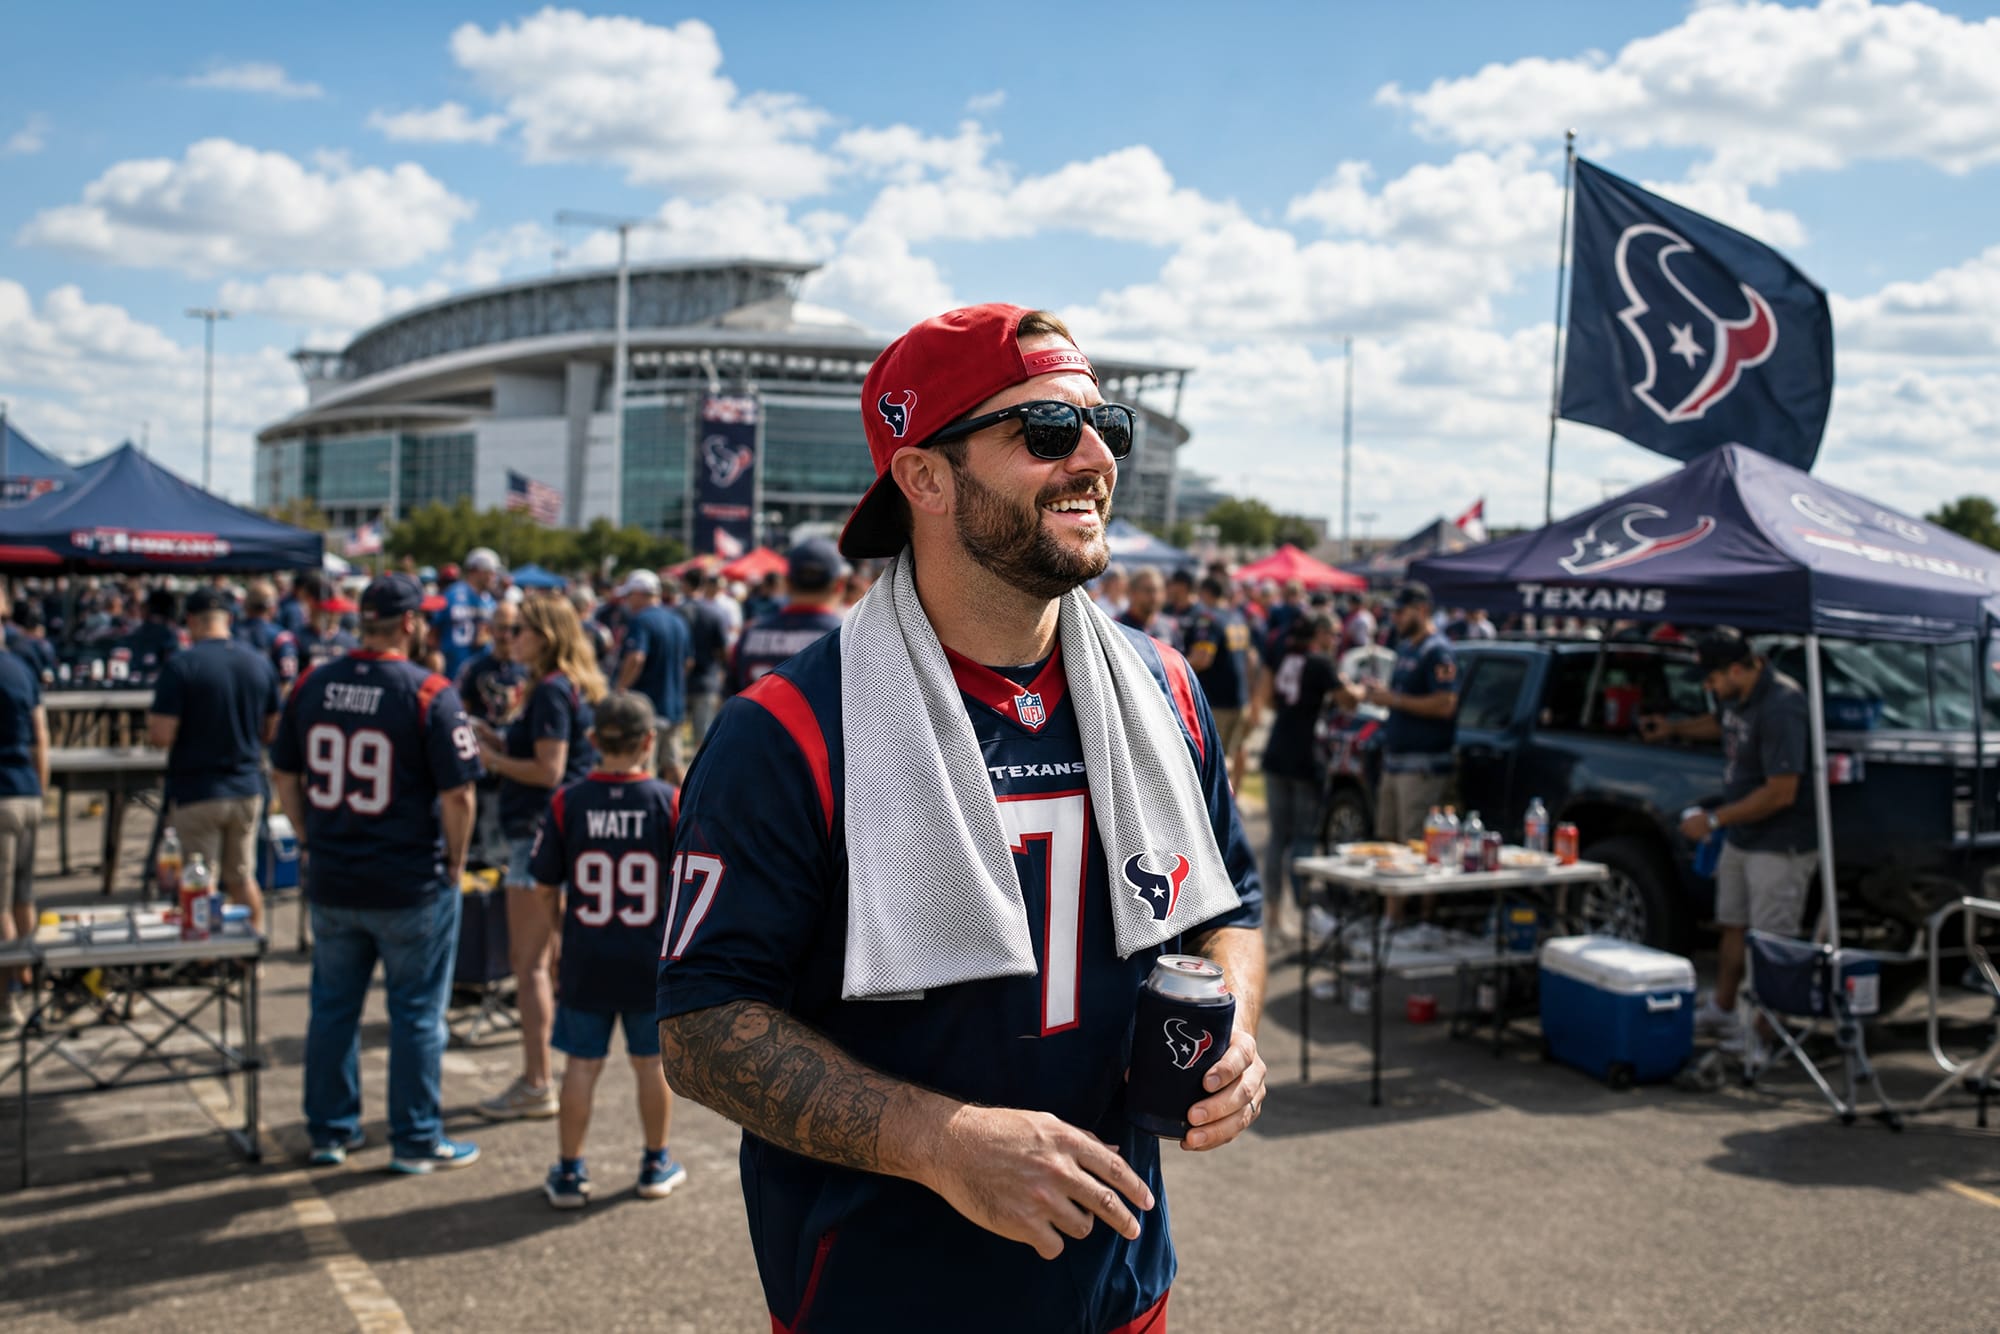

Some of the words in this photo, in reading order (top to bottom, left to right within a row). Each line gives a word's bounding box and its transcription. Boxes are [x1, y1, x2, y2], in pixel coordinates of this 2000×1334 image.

[1517, 583, 1666, 612] TEXANS
[1022, 706, 1042, 722] NFL
[307, 723, 393, 815] 99
[988, 762, 1085, 780] TEXANS
[586, 809, 647, 839] WATT
[575, 849, 659, 927] 99
[659, 851, 727, 960] 17
[995, 788, 1089, 1037] 7
